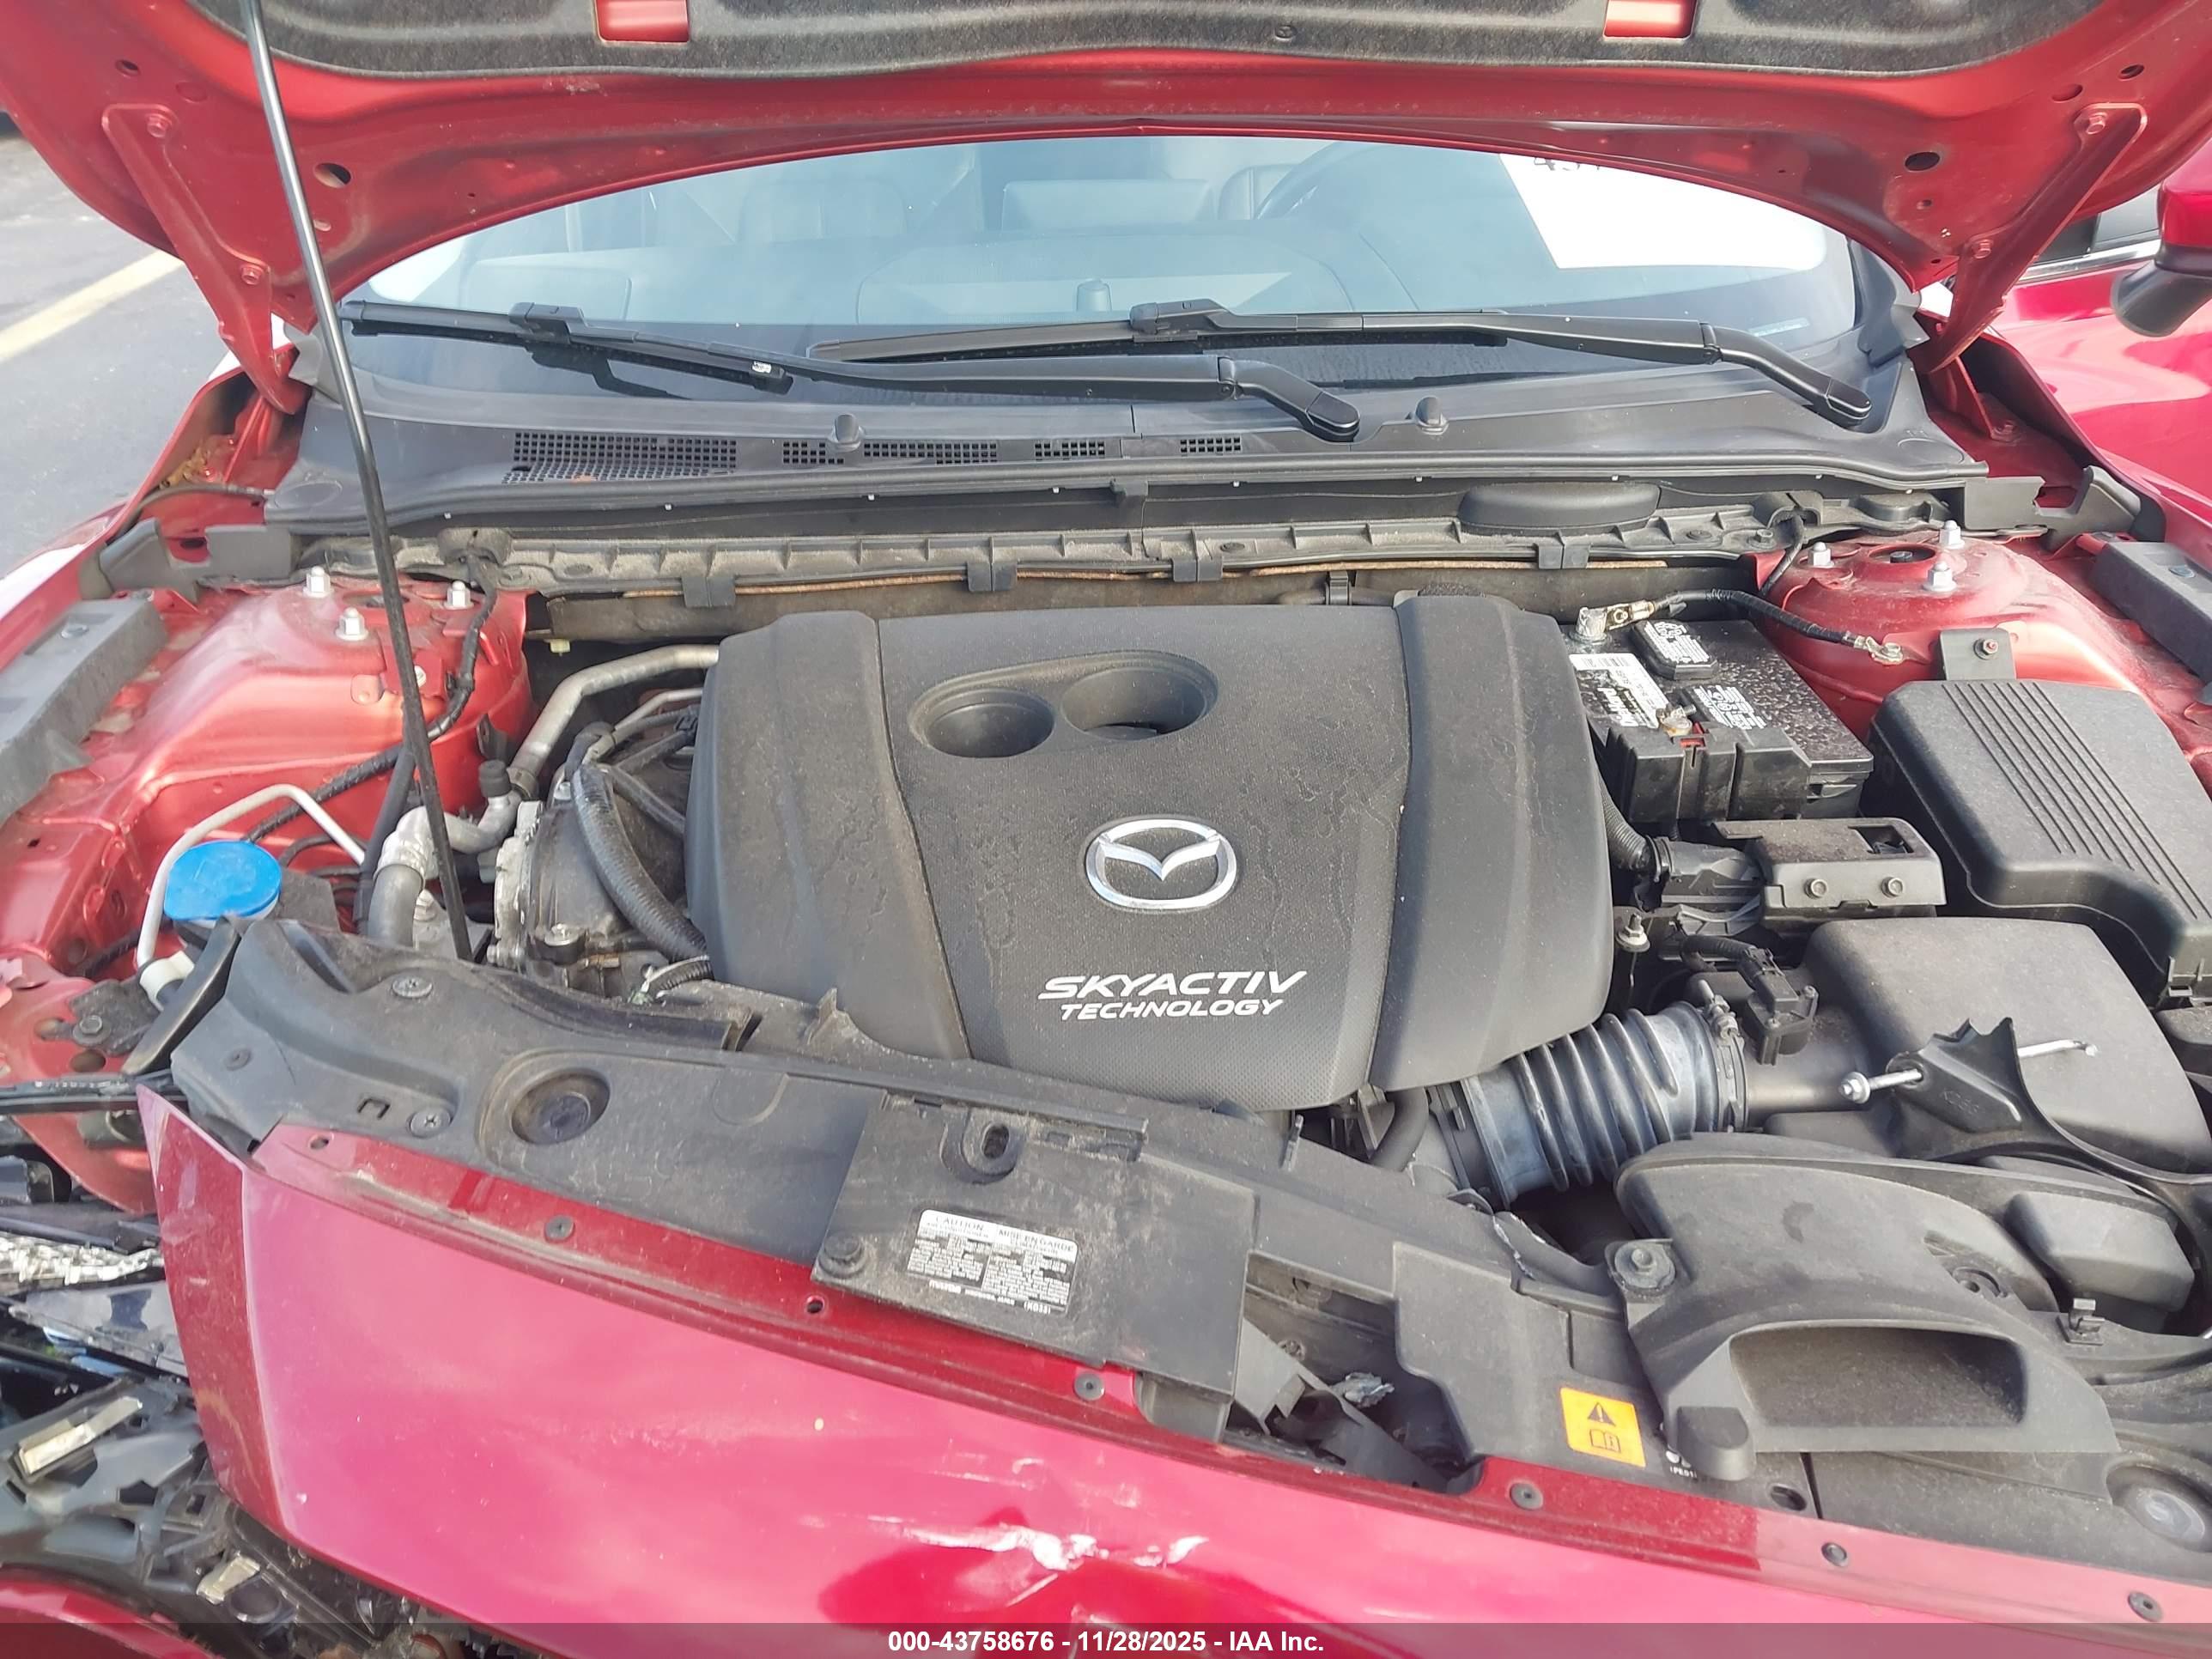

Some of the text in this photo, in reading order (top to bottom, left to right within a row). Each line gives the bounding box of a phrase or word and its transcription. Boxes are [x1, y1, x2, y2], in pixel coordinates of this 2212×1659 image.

[1037, 969, 1308, 1000] SKYACTIV
[1060, 999, 1284, 1021] TECHNOLOGY
[935, 1216, 984, 1231] CAUTION
